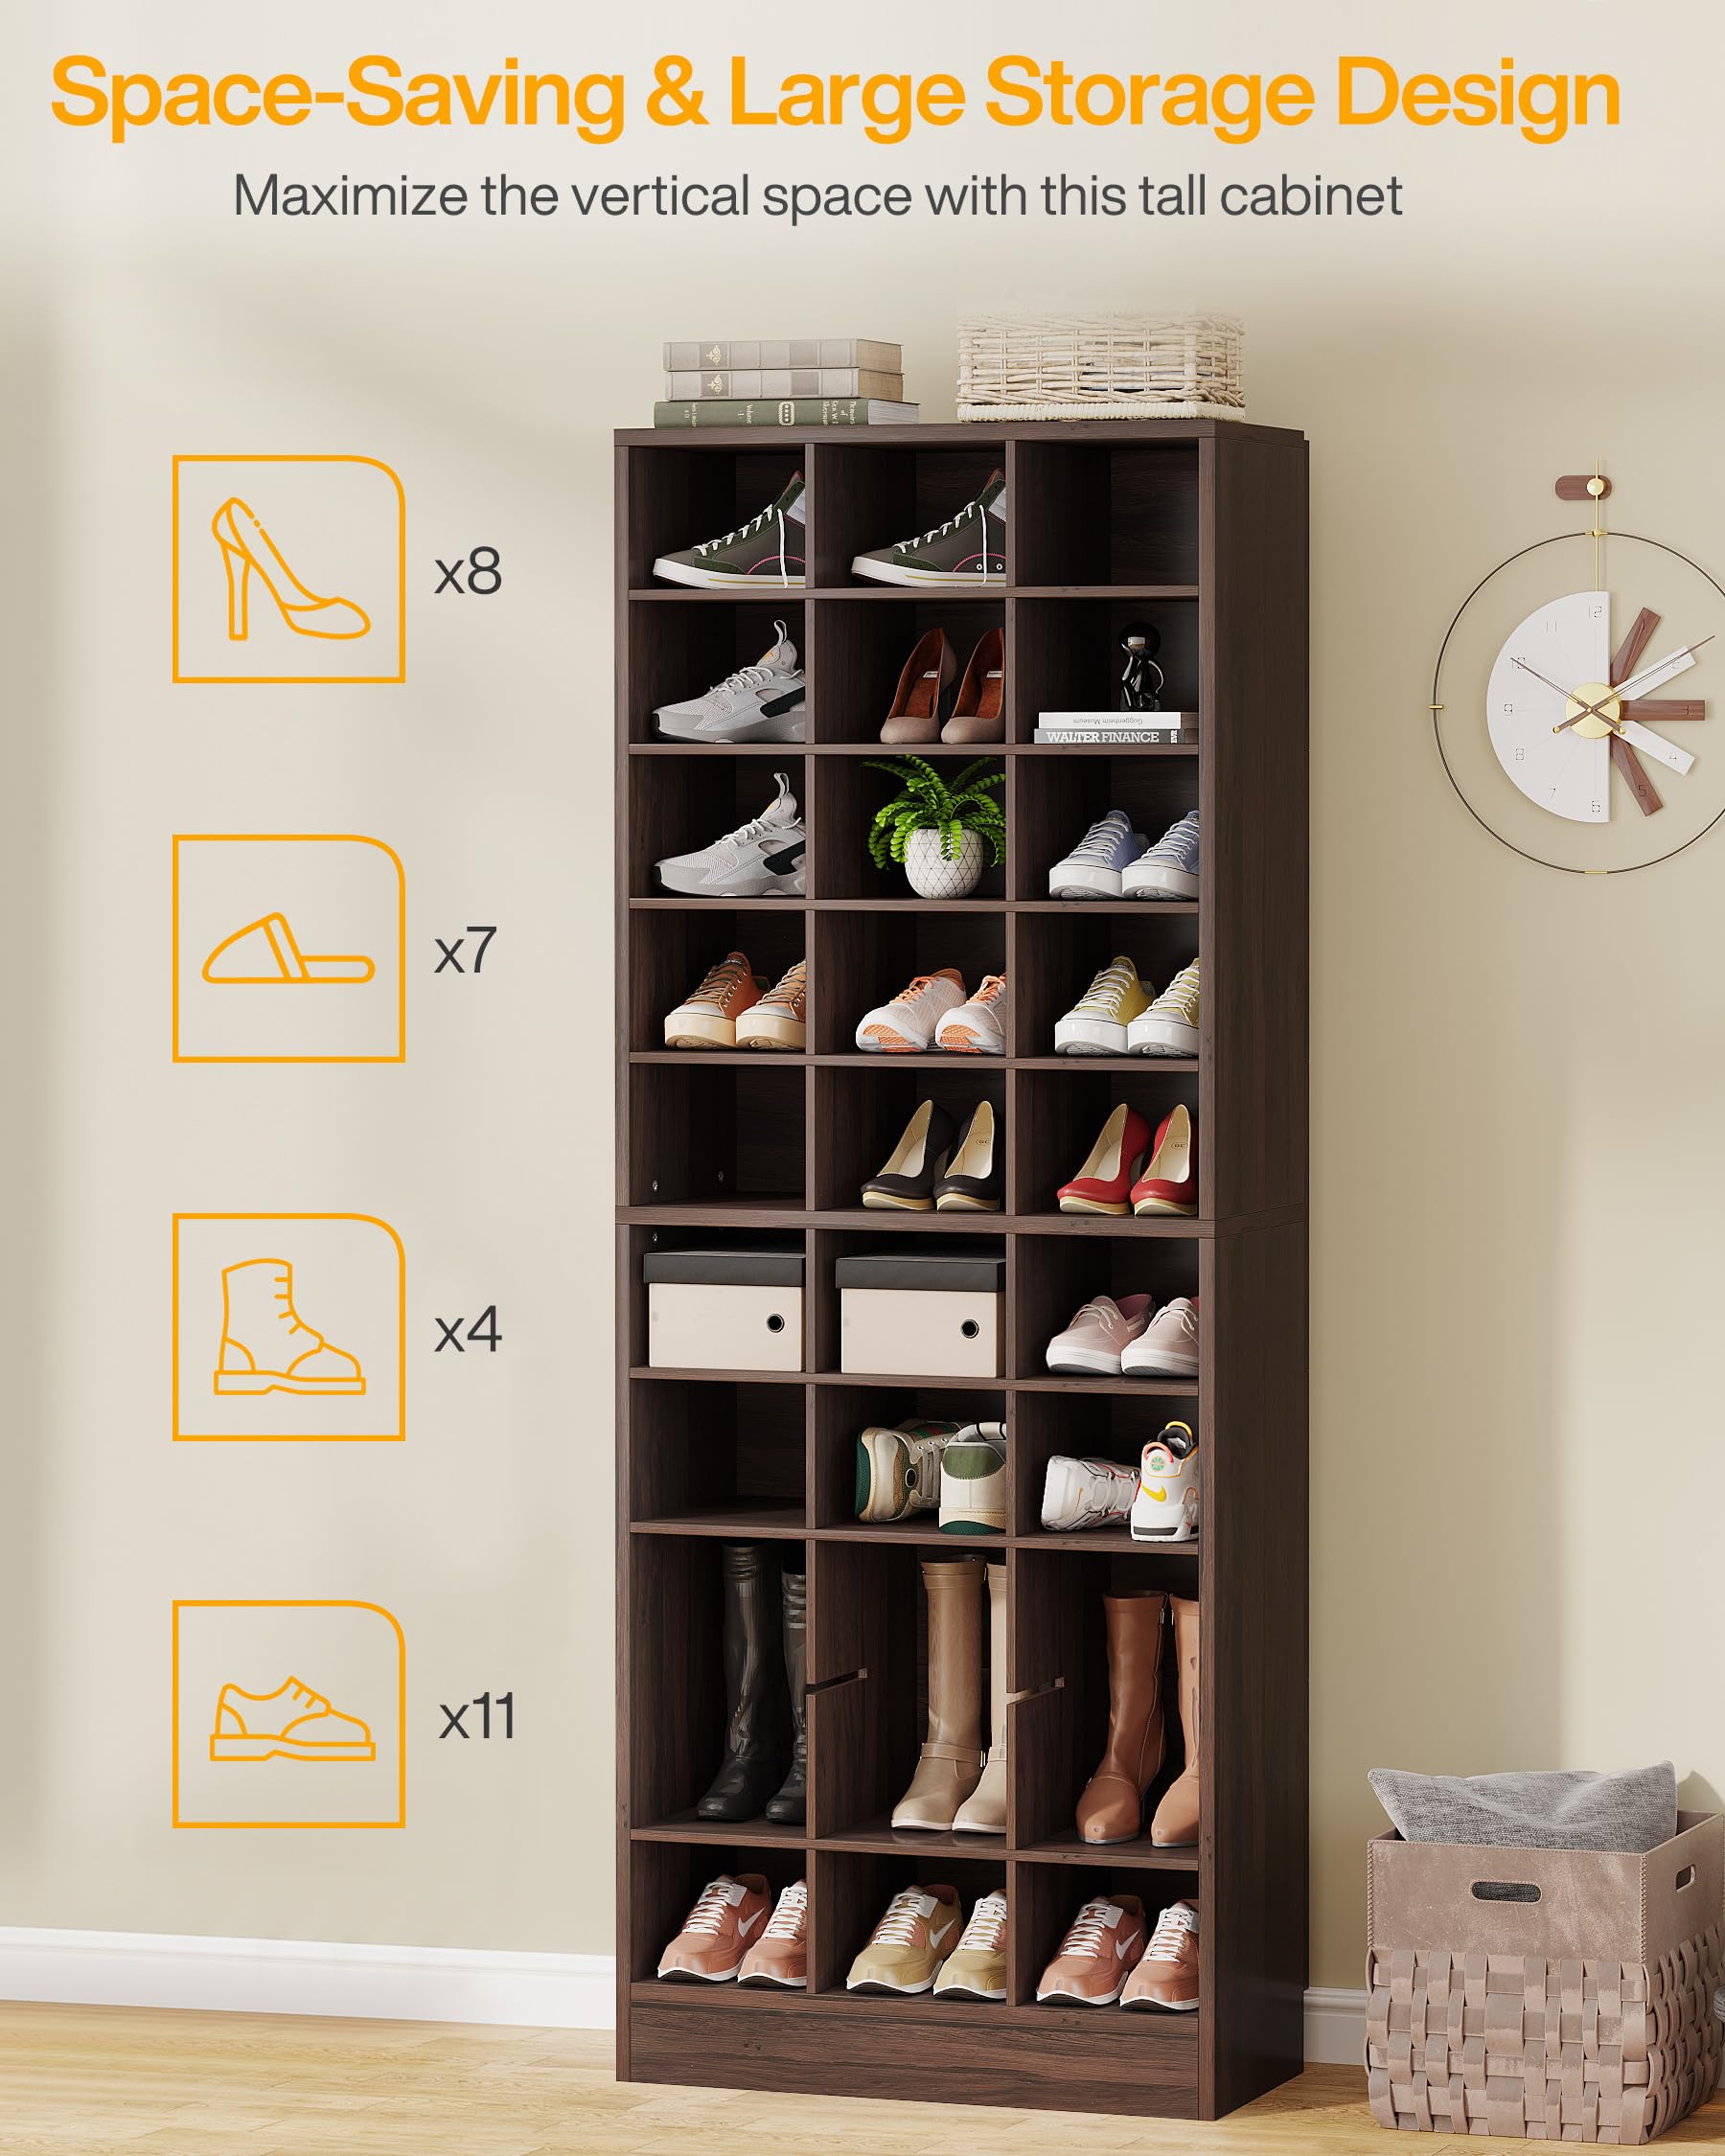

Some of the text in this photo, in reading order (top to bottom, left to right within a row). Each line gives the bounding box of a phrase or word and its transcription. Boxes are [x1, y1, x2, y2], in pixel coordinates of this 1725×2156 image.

[1102, 717, 1143, 725] Guggenheim
[1046, 731, 1160, 744] WALTER FINANCE
